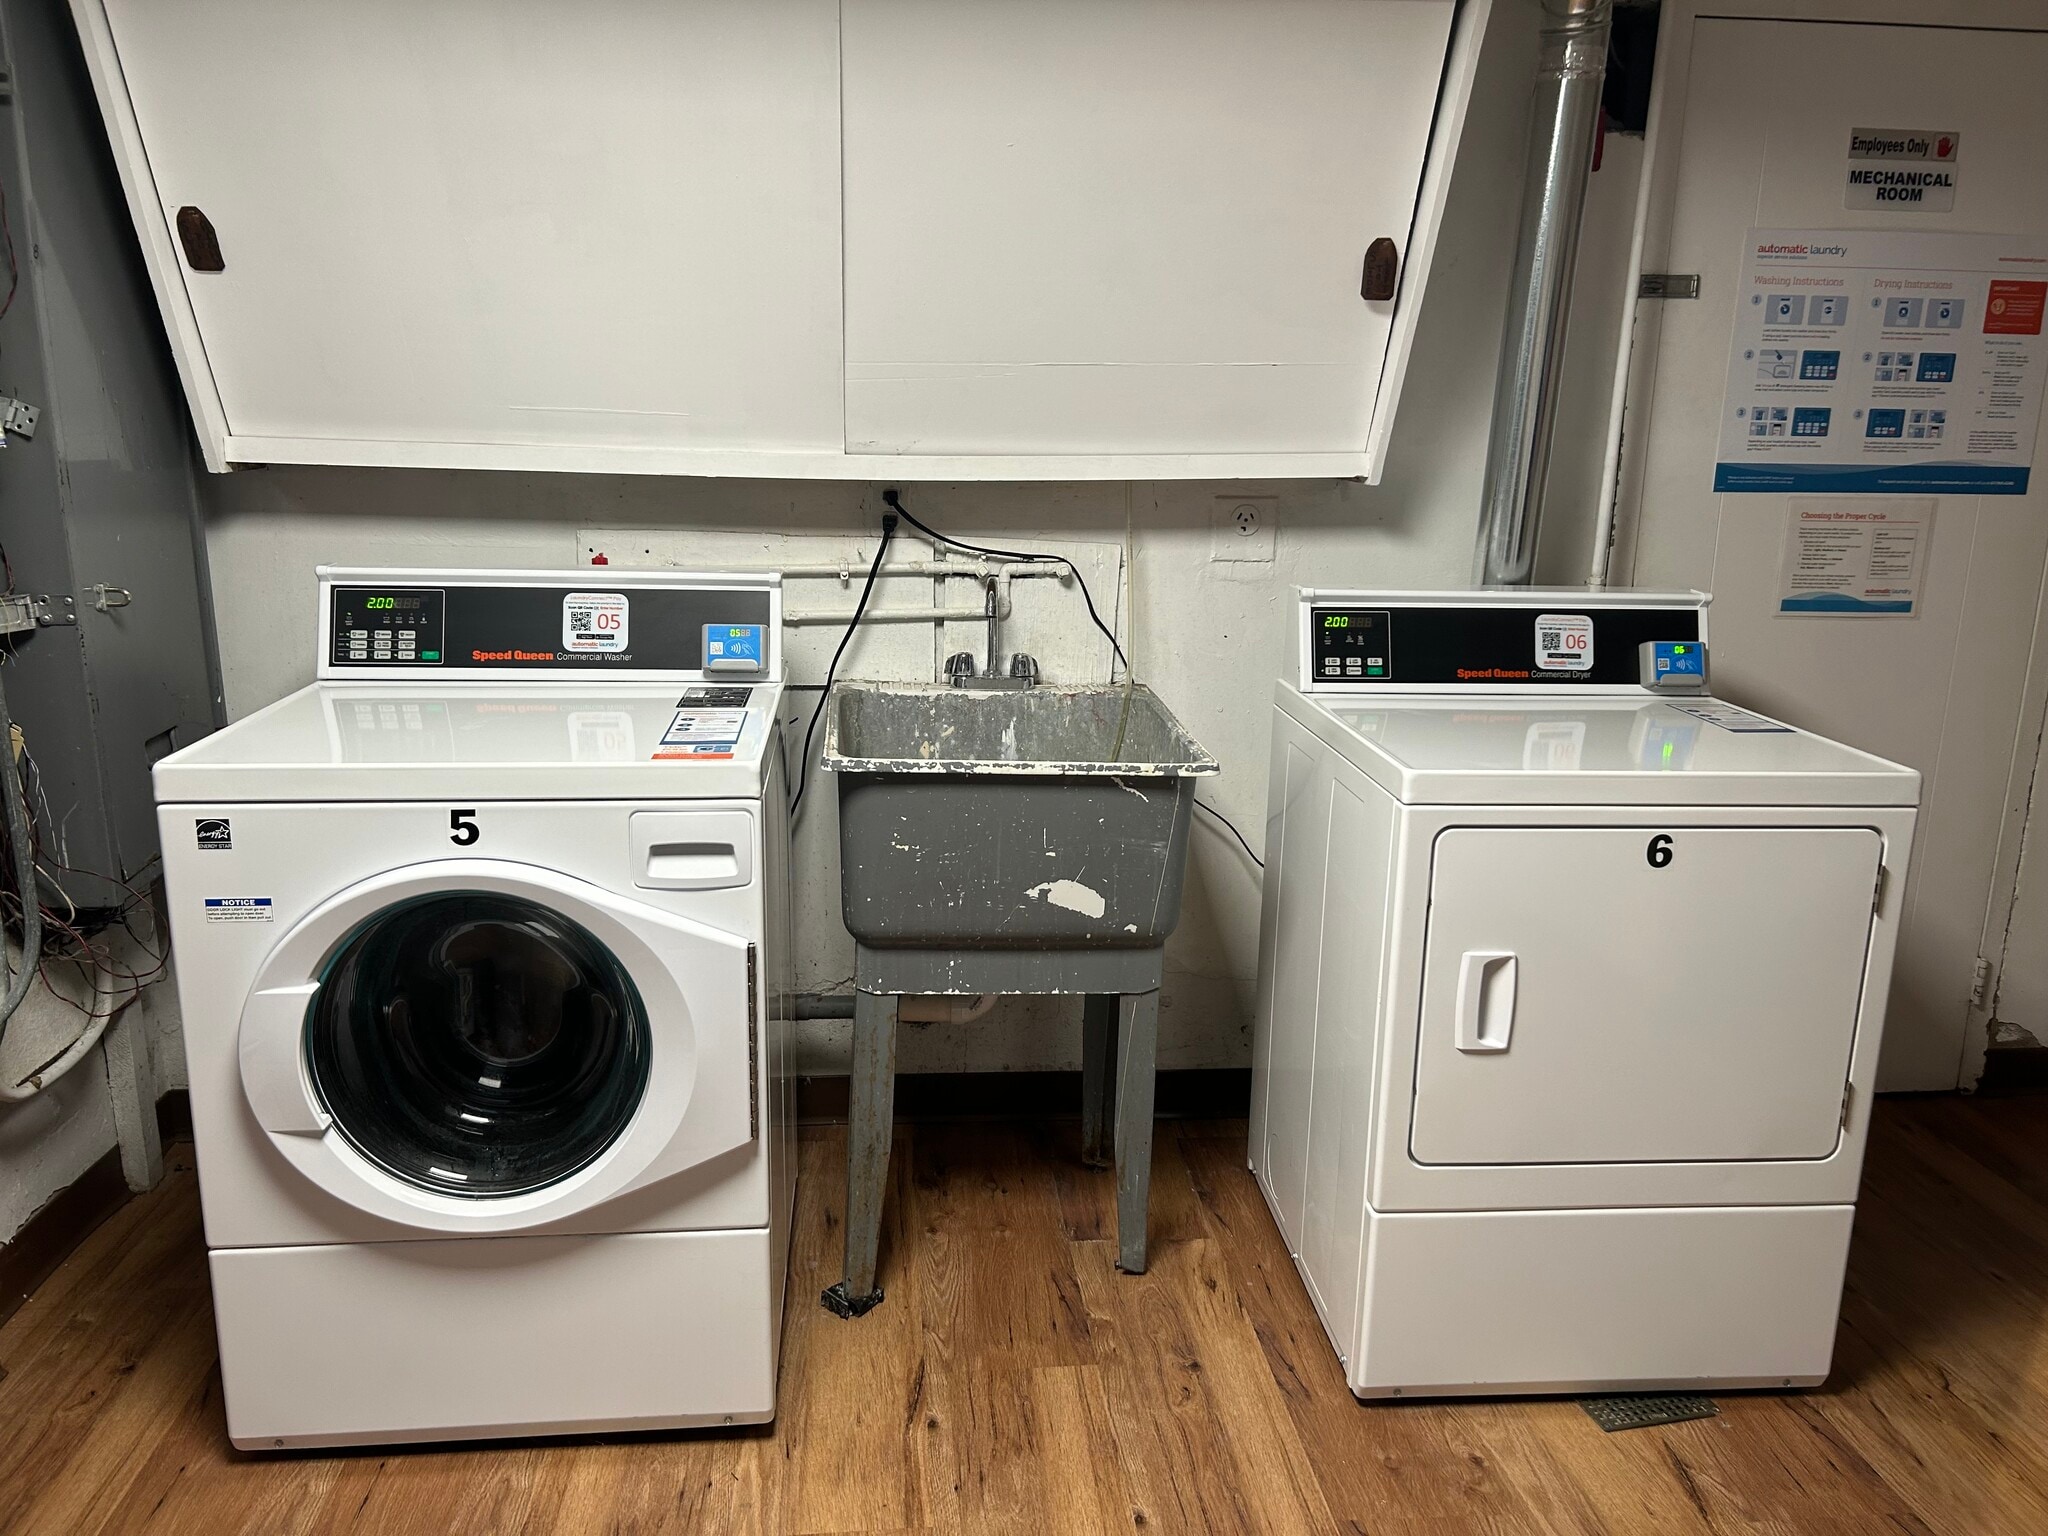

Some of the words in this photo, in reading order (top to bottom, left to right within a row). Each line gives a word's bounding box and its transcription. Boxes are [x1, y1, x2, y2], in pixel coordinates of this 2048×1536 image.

[1851, 137, 1904, 155] Employees
[1907, 139, 1930, 157] Only
[1850, 171, 1952, 187] MECHANICAL
[1876, 187, 1923, 201] ROOM
[1758, 244, 1808, 254] automatic
[1810, 245, 1847, 257] laundry
[1754, 276, 1791, 287] Washing
[1792, 277, 1844, 286] Instructions
[1874, 279, 1902, 289] Drying
[1904, 280, 1952, 289] Instructions
[1801, 512, 1831, 520] Choosing
[1845, 513, 1866, 521] Proper
[1868, 513, 1886, 521] Cycle
[367, 598, 394, 609] 2.00
[597, 613, 621, 630] 05
[1324, 616, 1348, 627] 2.00
[1566, 634, 1587, 650] 06
[472, 650, 512, 661] Speed
[514, 650, 554, 661] Queen
[557, 652, 602, 661] Commercial
[604, 652, 633, 661] Washer
[1457, 669, 1492, 680] Speed
[1493, 669, 1529, 678] Queen
[1531, 670, 1571, 678] Commercial
[1573, 671, 1591, 680] Dryer
[450, 809, 480, 846] 5
[1646, 834, 1673, 868] 6
